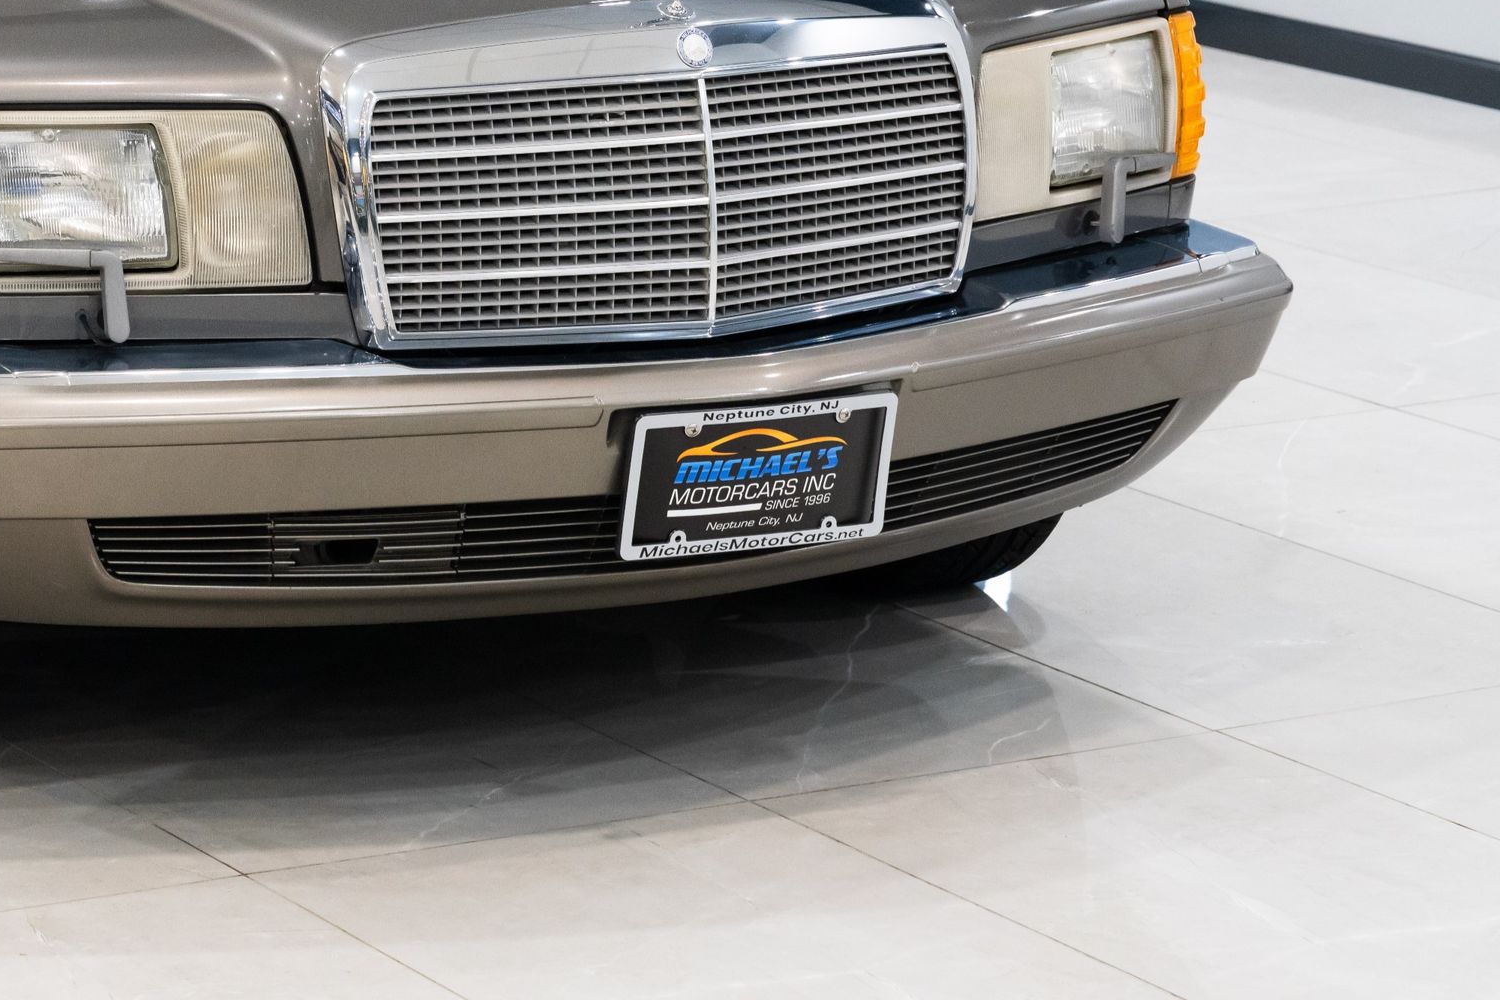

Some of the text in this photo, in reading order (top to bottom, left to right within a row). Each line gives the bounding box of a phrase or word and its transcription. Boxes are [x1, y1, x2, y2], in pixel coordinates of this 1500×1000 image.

[703, 409, 775, 422] Neptune
[820, 400, 839, 411] NJ
[674, 446, 843, 484] MICHAEL'S
[669, 473, 836, 506] MOTORCARS INC
[765, 493, 831, 511] SINCE 1996
[705, 519, 755, 532] Neptune
[785, 512, 803, 523] NJ
[639, 528, 864, 558] MichaelsMotorCars.net
